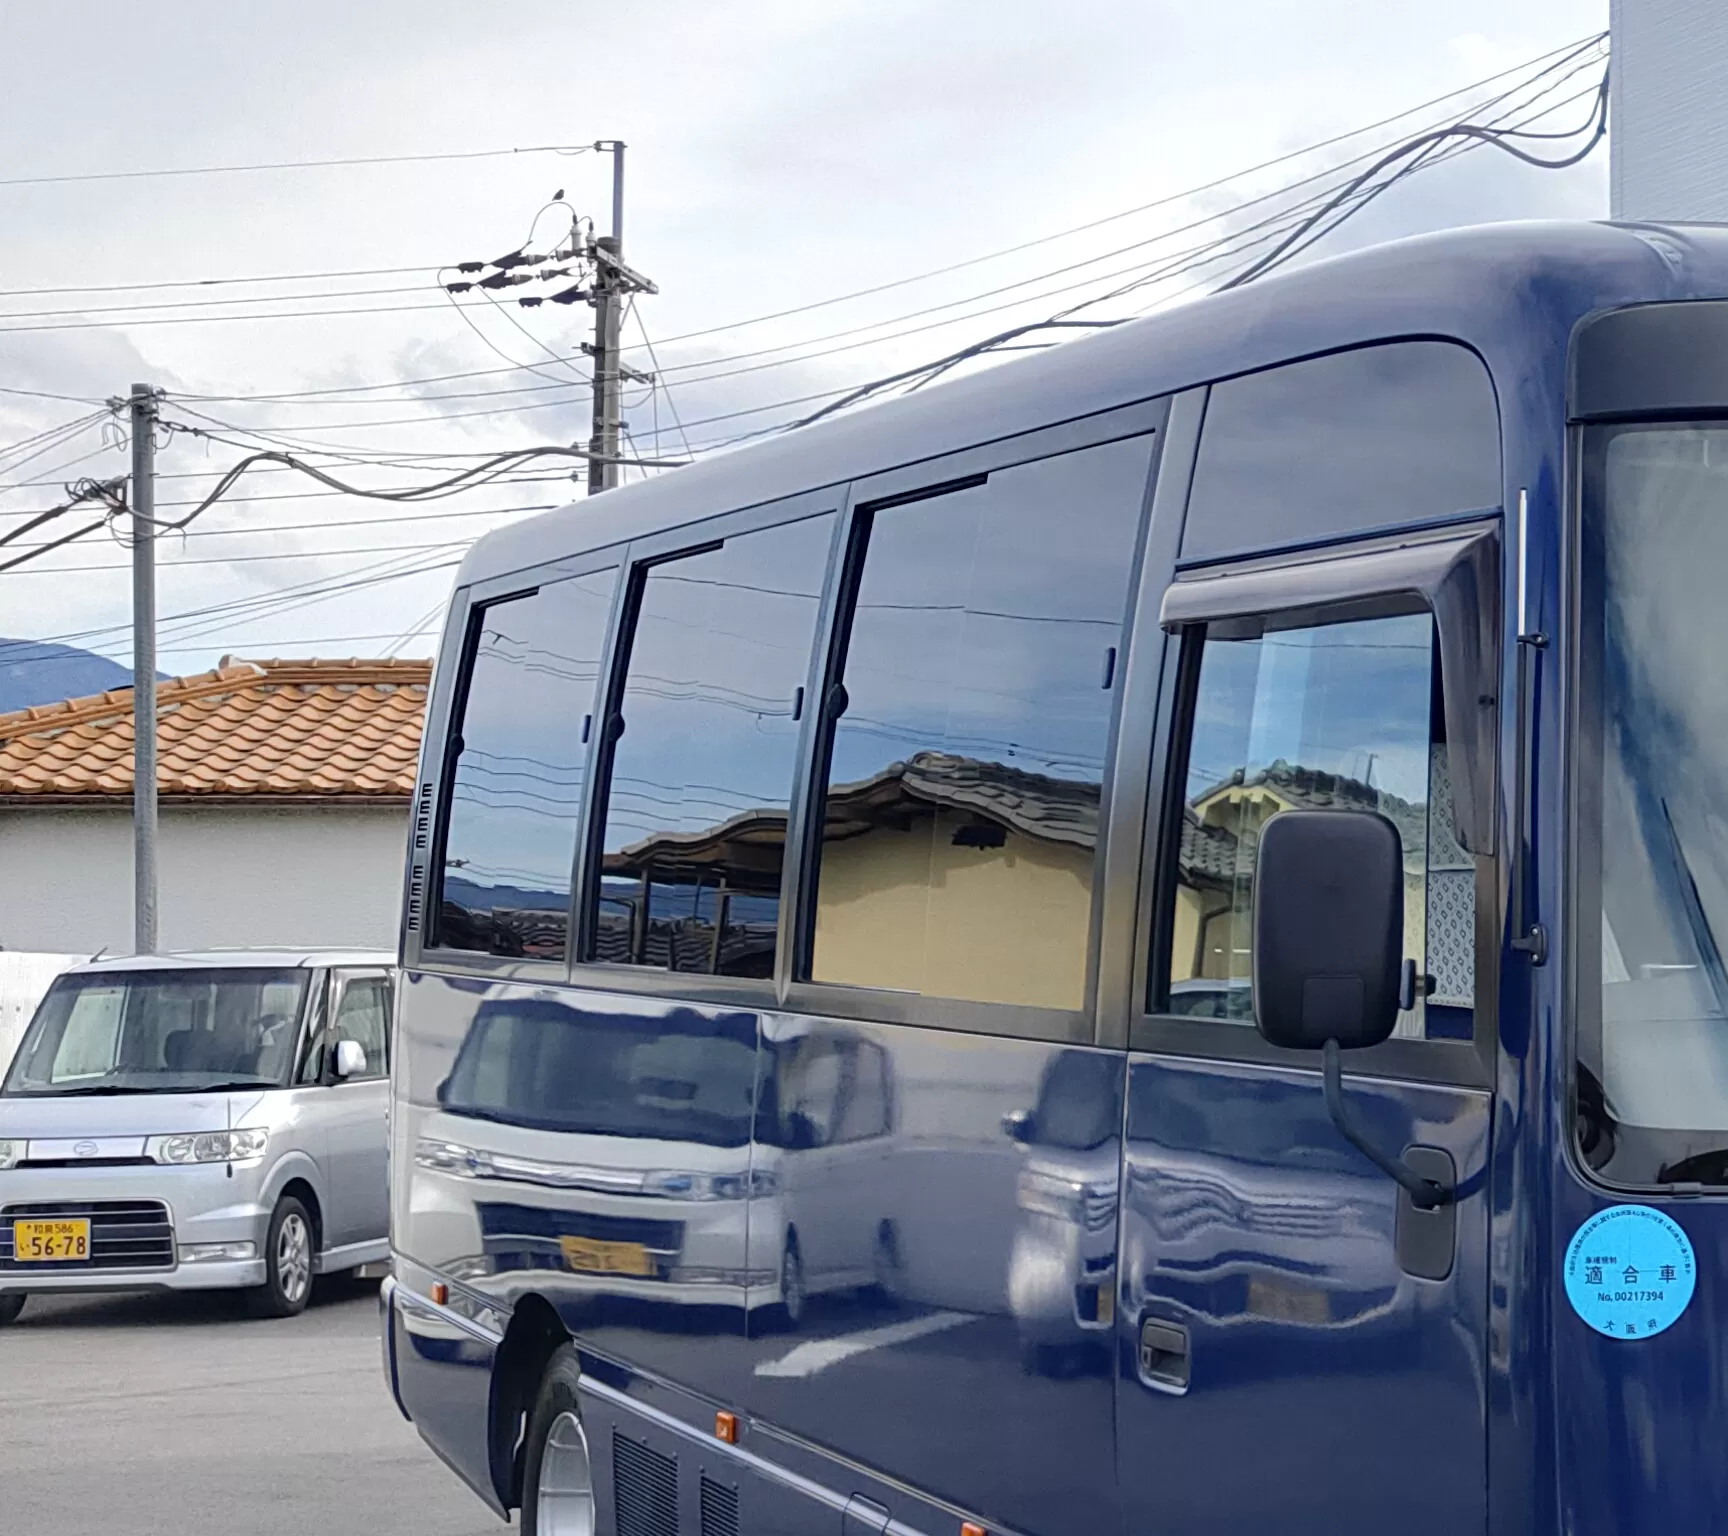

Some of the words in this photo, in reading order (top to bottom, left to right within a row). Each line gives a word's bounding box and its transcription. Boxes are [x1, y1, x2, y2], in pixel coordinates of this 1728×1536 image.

[31, 1235, 86, 1256] 56-78
[1584, 1264, 1677, 1285] 適合車
